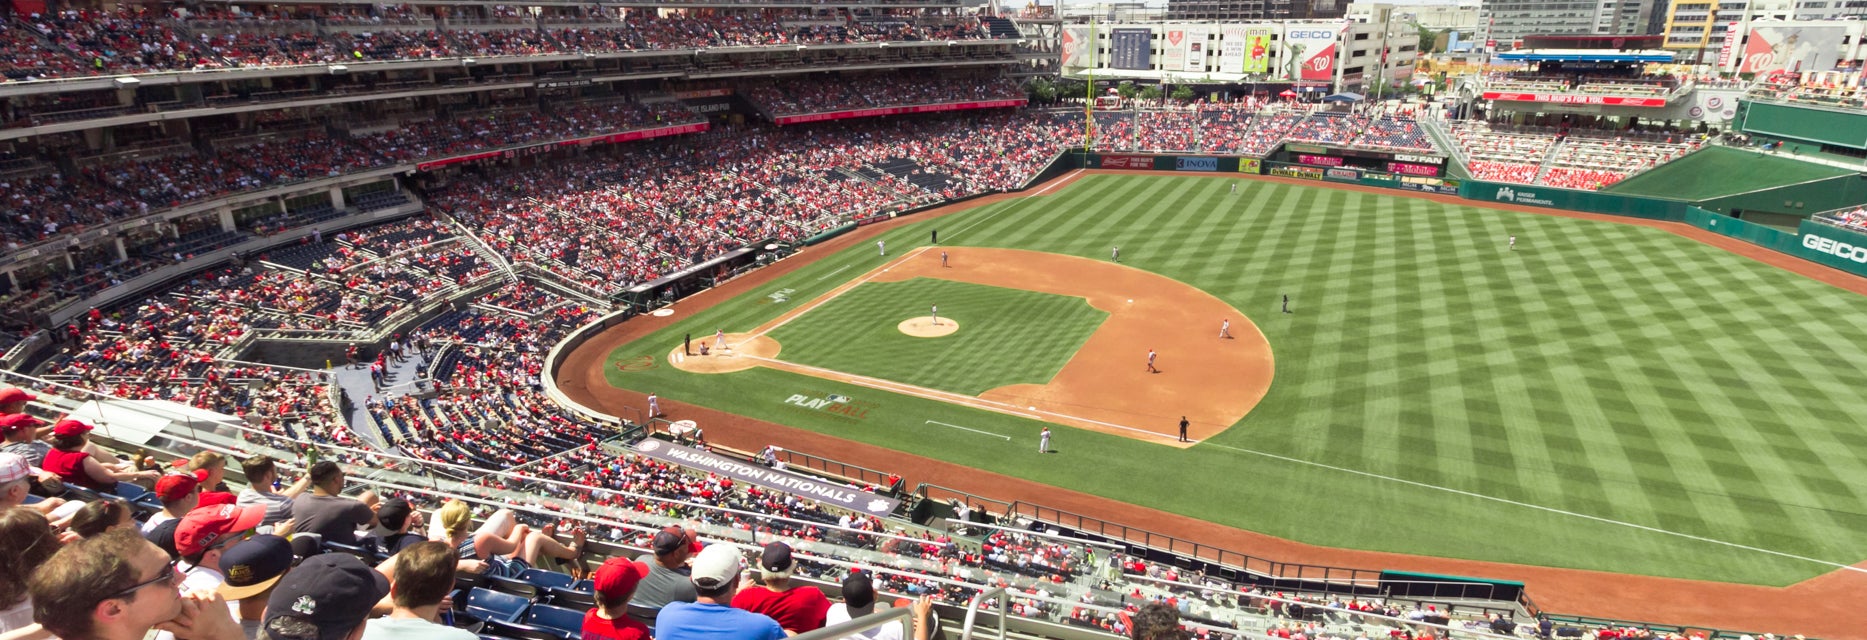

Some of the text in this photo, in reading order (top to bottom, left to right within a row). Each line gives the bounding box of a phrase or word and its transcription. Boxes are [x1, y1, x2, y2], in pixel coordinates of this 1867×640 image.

[1290, 31, 1332, 39] GEICO
[701, 104, 719, 112] ISLAND
[719, 103, 730, 111] PUB
[1186, 159, 1216, 168] INOVA
[1418, 155, 1443, 164] FAN
[1802, 233, 1867, 264] GEICO
[784, 393, 832, 410] PLAY
[827, 402, 869, 419] BALL
[666, 447, 857, 503] WASHINGTON NATIONALS
